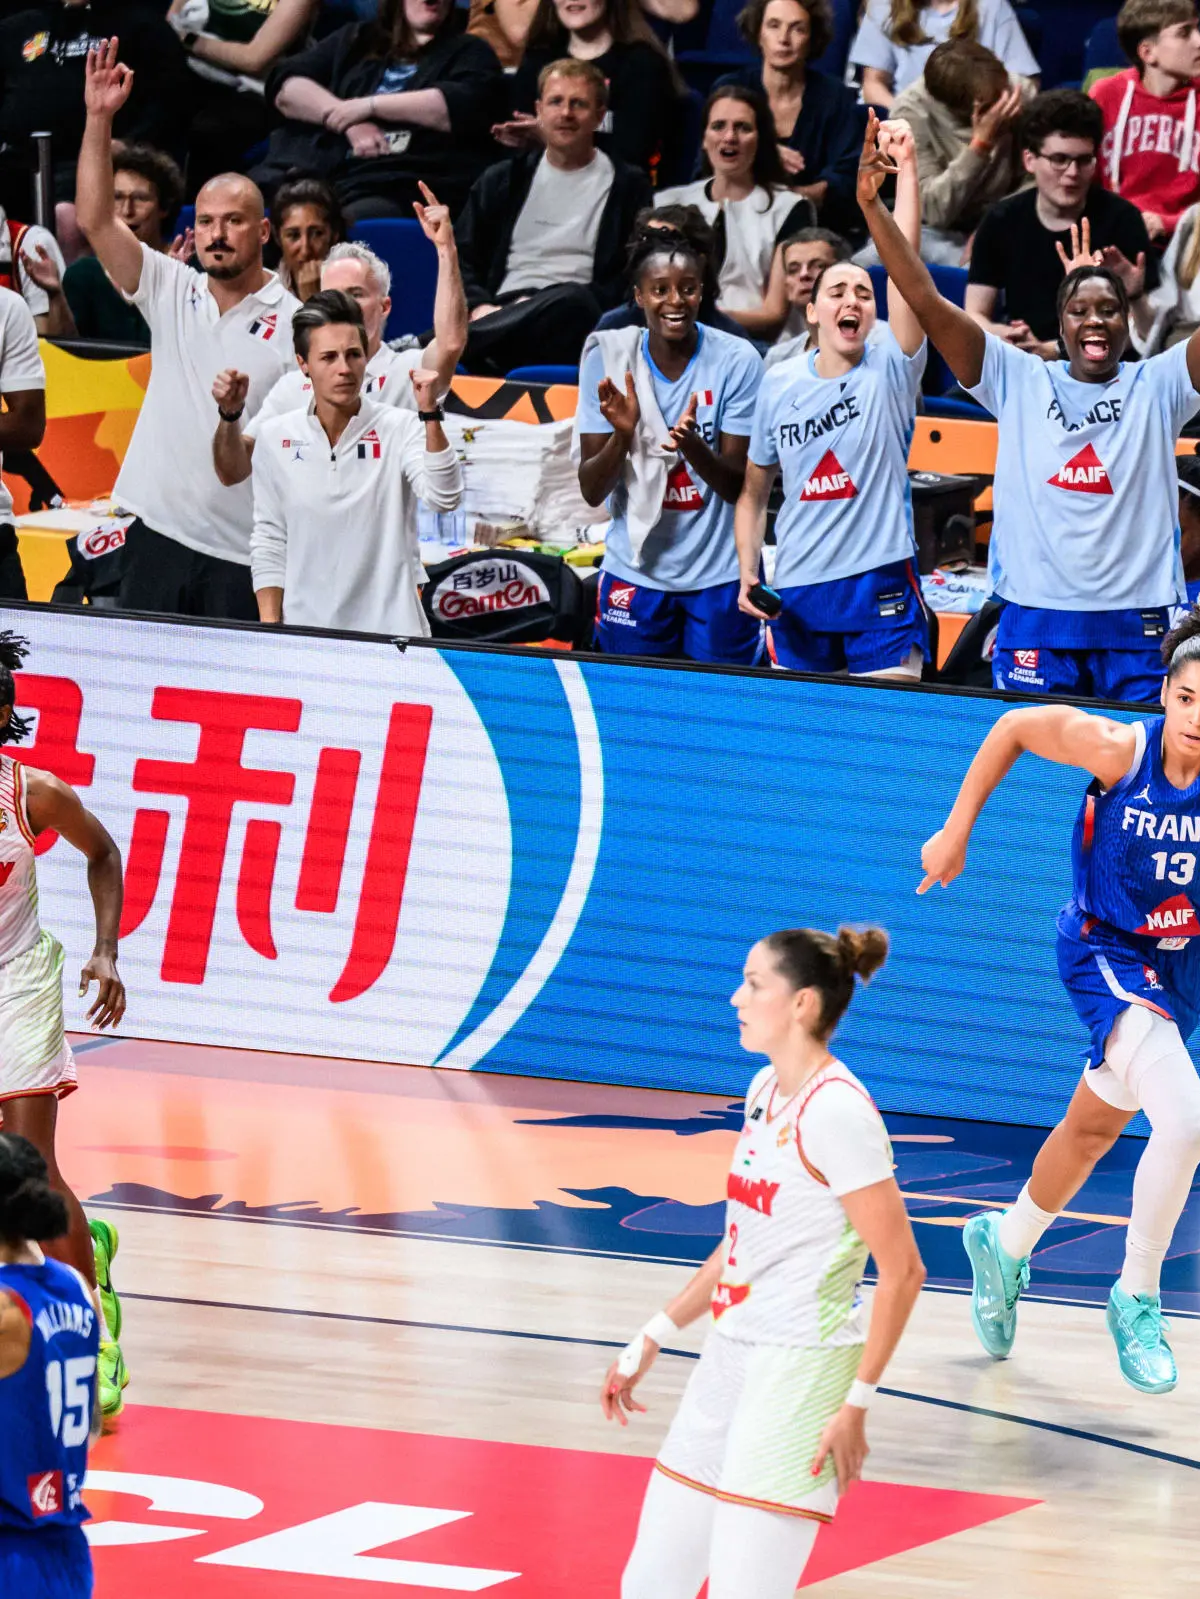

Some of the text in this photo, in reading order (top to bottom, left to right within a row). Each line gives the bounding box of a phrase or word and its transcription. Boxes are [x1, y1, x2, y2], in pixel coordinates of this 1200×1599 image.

[780, 396, 861, 448] FRANCE
[803, 472, 849, 495] MAIF
[1058, 466, 1107, 484] MAIF
[668, 484, 698, 502] AIF
[452, 564, 519, 591] 百岁山
[1151, 852, 1198, 886] 13
[1145, 909, 1195, 931] MAIF
[46, 1355, 96, 1448] 15
